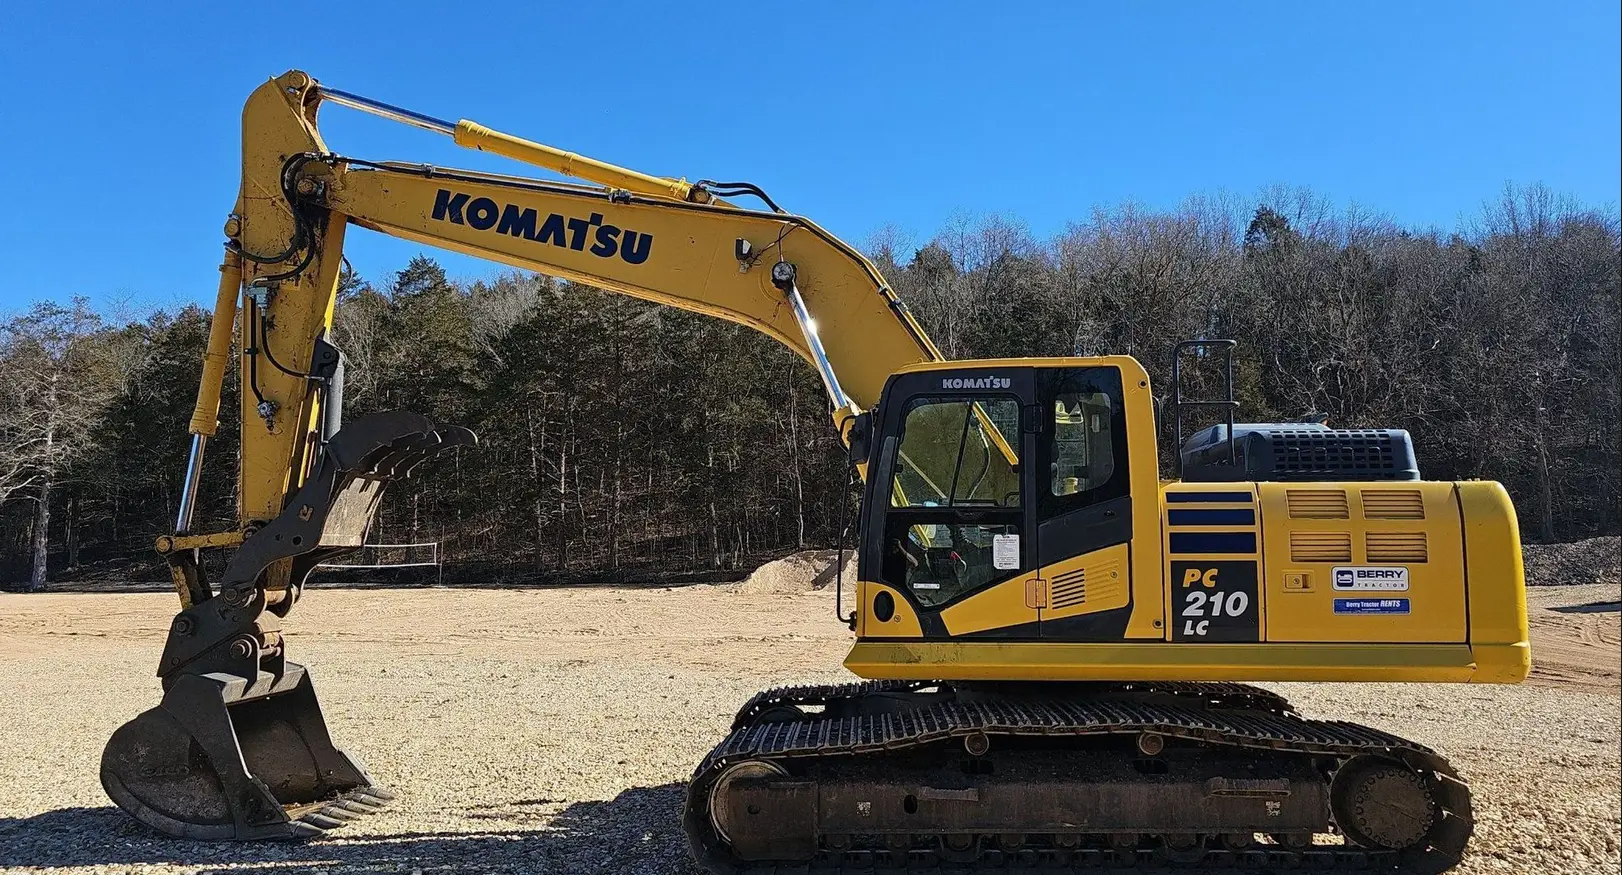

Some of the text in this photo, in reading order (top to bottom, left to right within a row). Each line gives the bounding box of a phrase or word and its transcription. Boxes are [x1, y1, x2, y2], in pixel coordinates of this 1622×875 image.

[431, 189, 653, 264] KOMATSU
[942, 375, 1011, 389] KOMATSU
[1183, 568, 1218, 588] PC
[1357, 570, 1403, 578] BERRY
[1182, 591, 1248, 617] 210
[1183, 620, 1209, 636] LC
